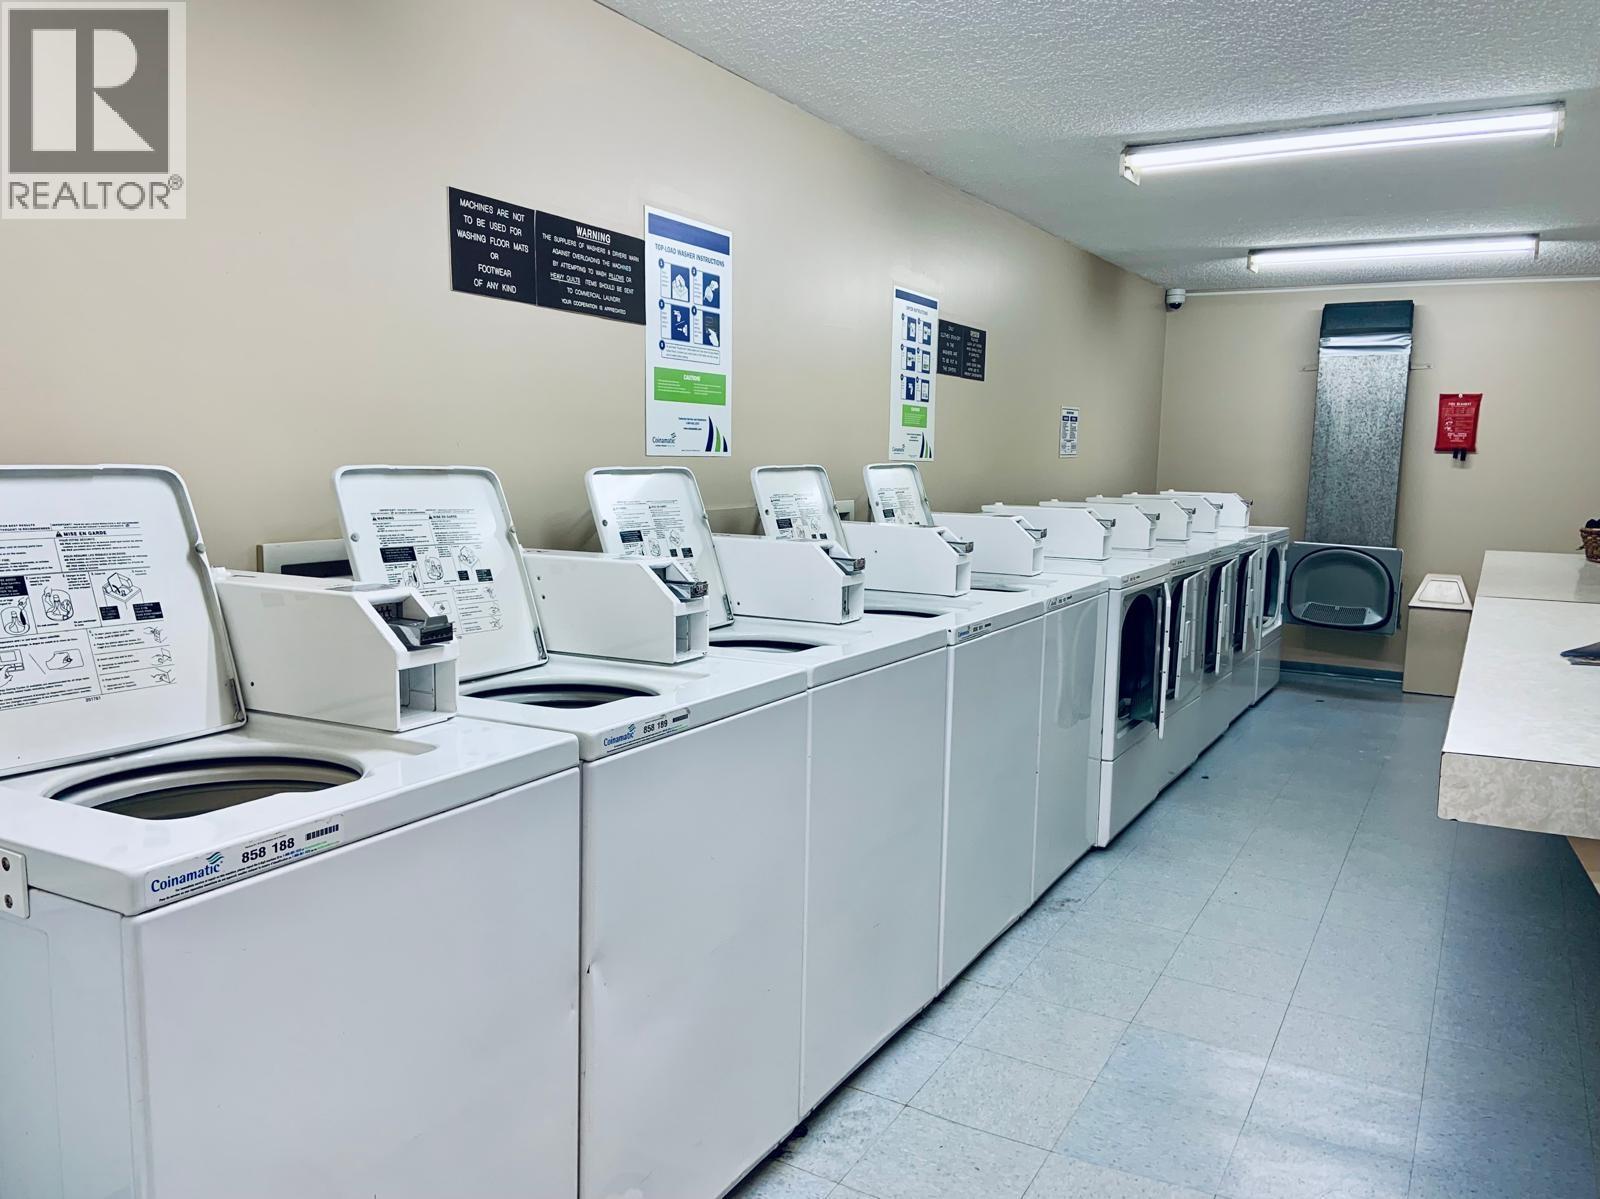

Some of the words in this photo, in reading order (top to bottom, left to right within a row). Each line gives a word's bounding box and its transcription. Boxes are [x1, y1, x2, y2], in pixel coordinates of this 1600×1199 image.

[460, 198, 494, 214] MACHINES
[497, 208, 509, 218] ARE
[513, 213, 525, 222] NOT
[464, 215, 472, 224] TO
[477, 219, 486, 228] BE
[490, 221, 506, 233] USED
[510, 226, 522, 236] FOR
[576, 226, 611, 243] WARNING
[456, 229, 486, 243] WASHING
[490, 236, 510, 248] FLOOR
[513, 243, 528, 253] MATS
[542, 232, 551, 241] THE
[554, 236, 576, 247] SUPPLIERS
[586, 244, 606, 255] WASHERS
[612, 250, 627, 259] DRYERS
[490, 252, 499, 260] OR
[552, 248, 570, 257] AGAINST
[572, 252, 600, 264] OVERLOADING
[612, 263, 632, 272] MACHINES
[655, 244, 676, 254] TOP-LOAD
[677, 250, 695, 260] WASHER
[696, 256, 725, 267] INSTRUCTIONS
[478, 264, 512, 278] FOOTWEAR
[561, 262, 586, 273] ATTEMPTING
[609, 273, 625, 281] PILLOWS
[474, 278, 483, 287] OF
[487, 280, 499, 290] ANY
[502, 284, 516, 294] KIND
[566, 275, 580, 283] QUILTS
[585, 279, 597, 287] ITEMS
[599, 282, 615, 290] SHOULD
[575, 290, 601, 299] COMMERCIAL
[573, 301, 598, 309] COOPERATION
[644, 724, 654, 734] 858
[604, 732, 634, 746] Coinamatic
[242, 846, 266, 863] 858
[272, 837, 295, 853] 188
[151, 863, 221, 892] Coinamatic
